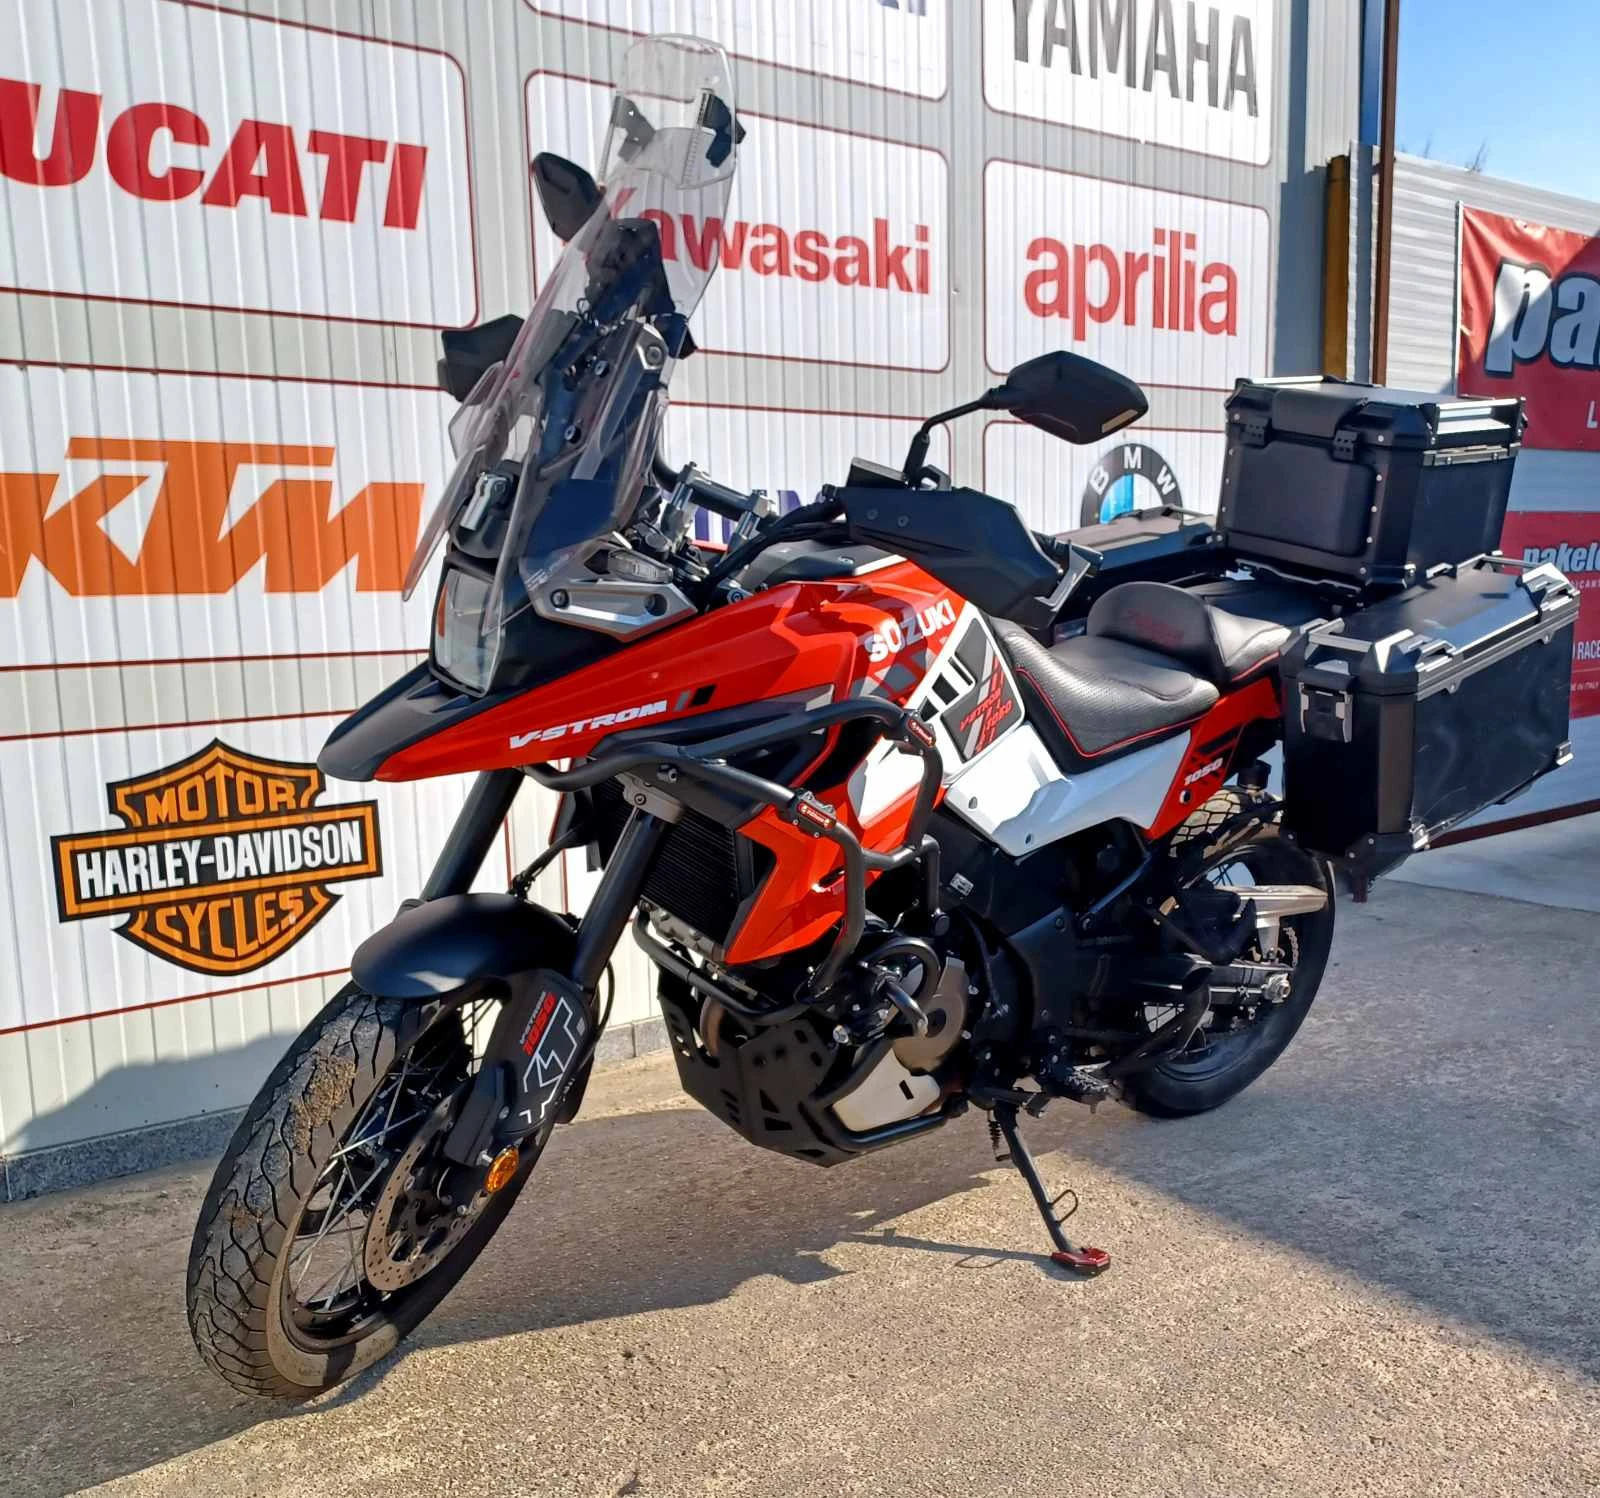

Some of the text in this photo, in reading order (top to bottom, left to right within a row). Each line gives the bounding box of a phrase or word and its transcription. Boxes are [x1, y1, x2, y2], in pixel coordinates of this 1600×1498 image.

[1012, 0, 1259, 118] YAMAHA
[0, 78, 428, 230] UCATI
[600, 188, 930, 295] awasaki
[1023, 228, 1239, 341] aprilia
[1485, 258, 1600, 377] pa
[1089, 446, 1176, 495] BMW
[0, 437, 425, 597] KTM
[509, 700, 668, 749] V-STROM
[144, 762, 298, 826] MOTOR
[1184, 757, 1224, 786] 1050
[77, 820, 362, 899] HARLEY-DAVIDSON
[155, 888, 304, 958] CYCLES
[522, 992, 558, 1057] 1050
